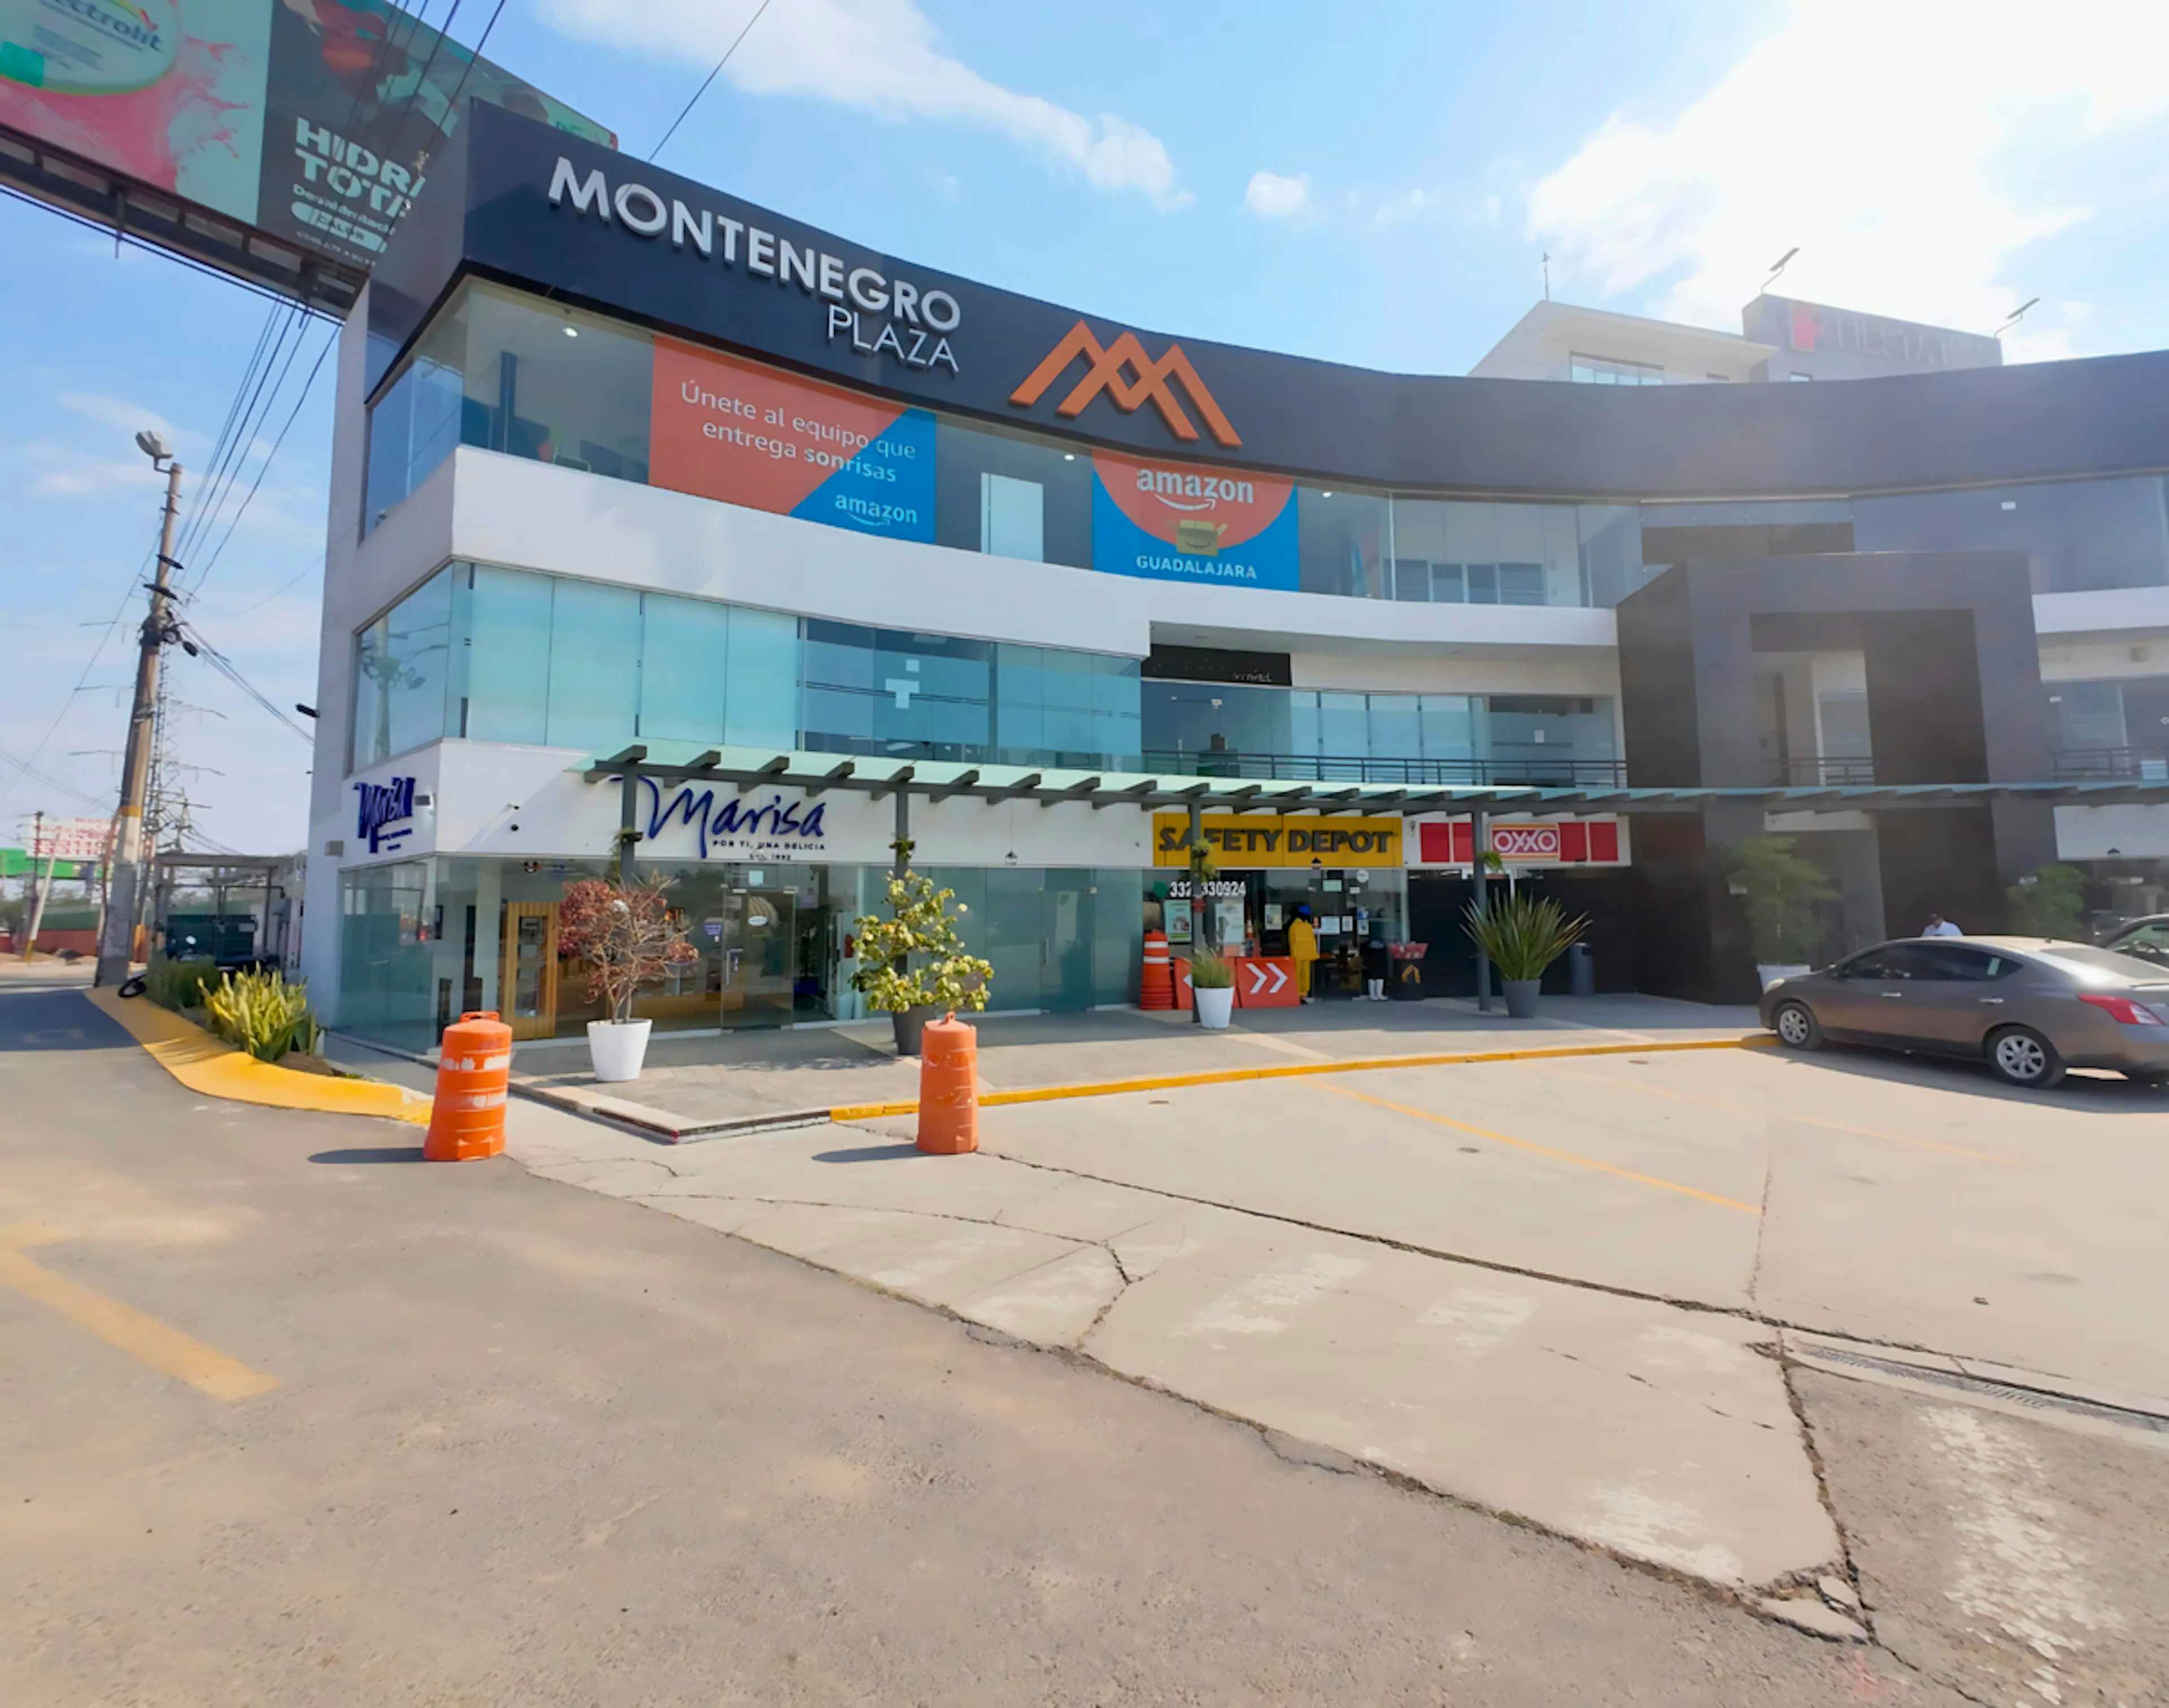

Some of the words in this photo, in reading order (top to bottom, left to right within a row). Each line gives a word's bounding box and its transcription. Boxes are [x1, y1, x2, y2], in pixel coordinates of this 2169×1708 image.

[58, 0, 163, 52] ctrolit
[548, 156, 961, 333] MONTENEGRO
[827, 304, 960, 373] PLAZA
[681, 379, 756, 420] Únete
[764, 407, 785, 427] al
[792, 412, 869, 450] equipo
[876, 438, 916, 460] que
[702, 420, 796, 459] entrega
[804, 448, 896, 482] sonrisas
[1136, 468, 1255, 504] amazon
[834, 493, 918, 525] amazon
[1136, 555, 1257, 580] GUADALAJARA
[609, 774, 826, 859] Marisa
[1287, 829, 1392, 853] DEPOT
[1493, 829, 1557, 853] OXXO
[1170, 880, 1246, 897] 332330924
